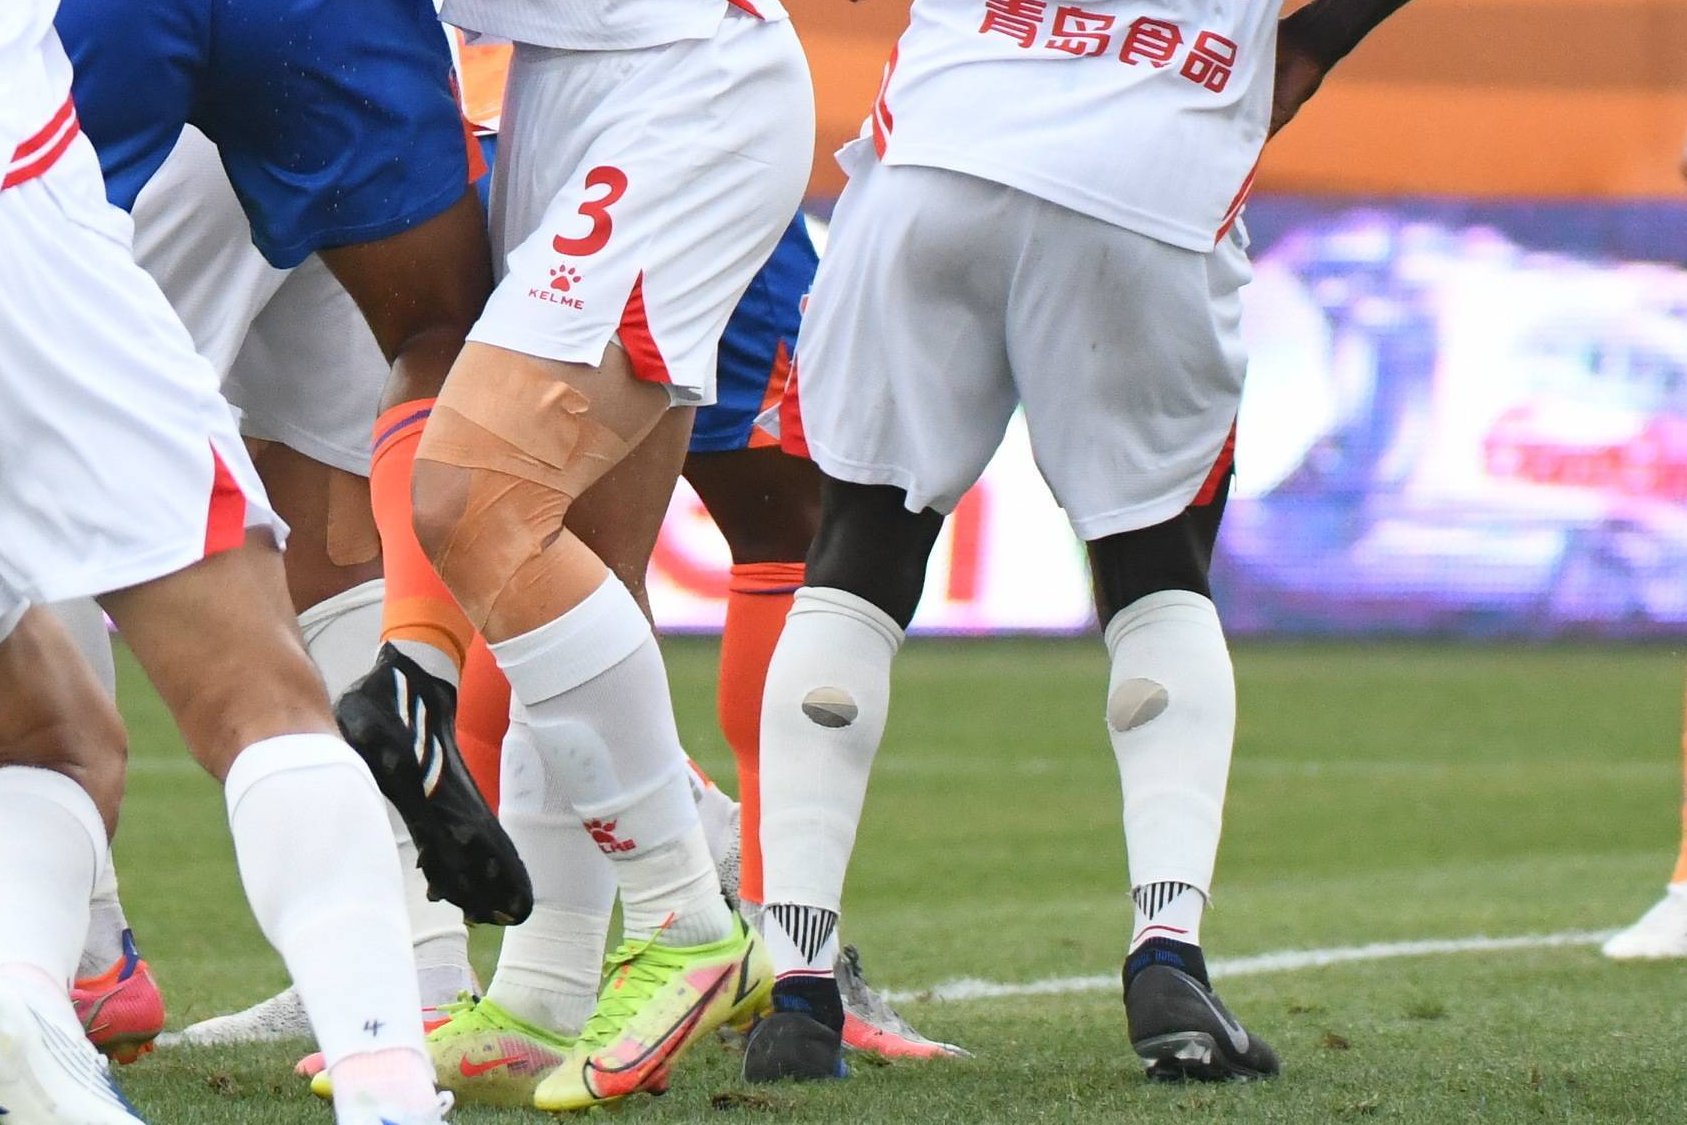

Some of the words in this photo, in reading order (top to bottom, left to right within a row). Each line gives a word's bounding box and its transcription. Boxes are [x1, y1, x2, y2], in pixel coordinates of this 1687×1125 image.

[552, 166, 628, 257] 3
[528, 288, 584, 310] KELME
[363, 1020, 386, 1037] 4
